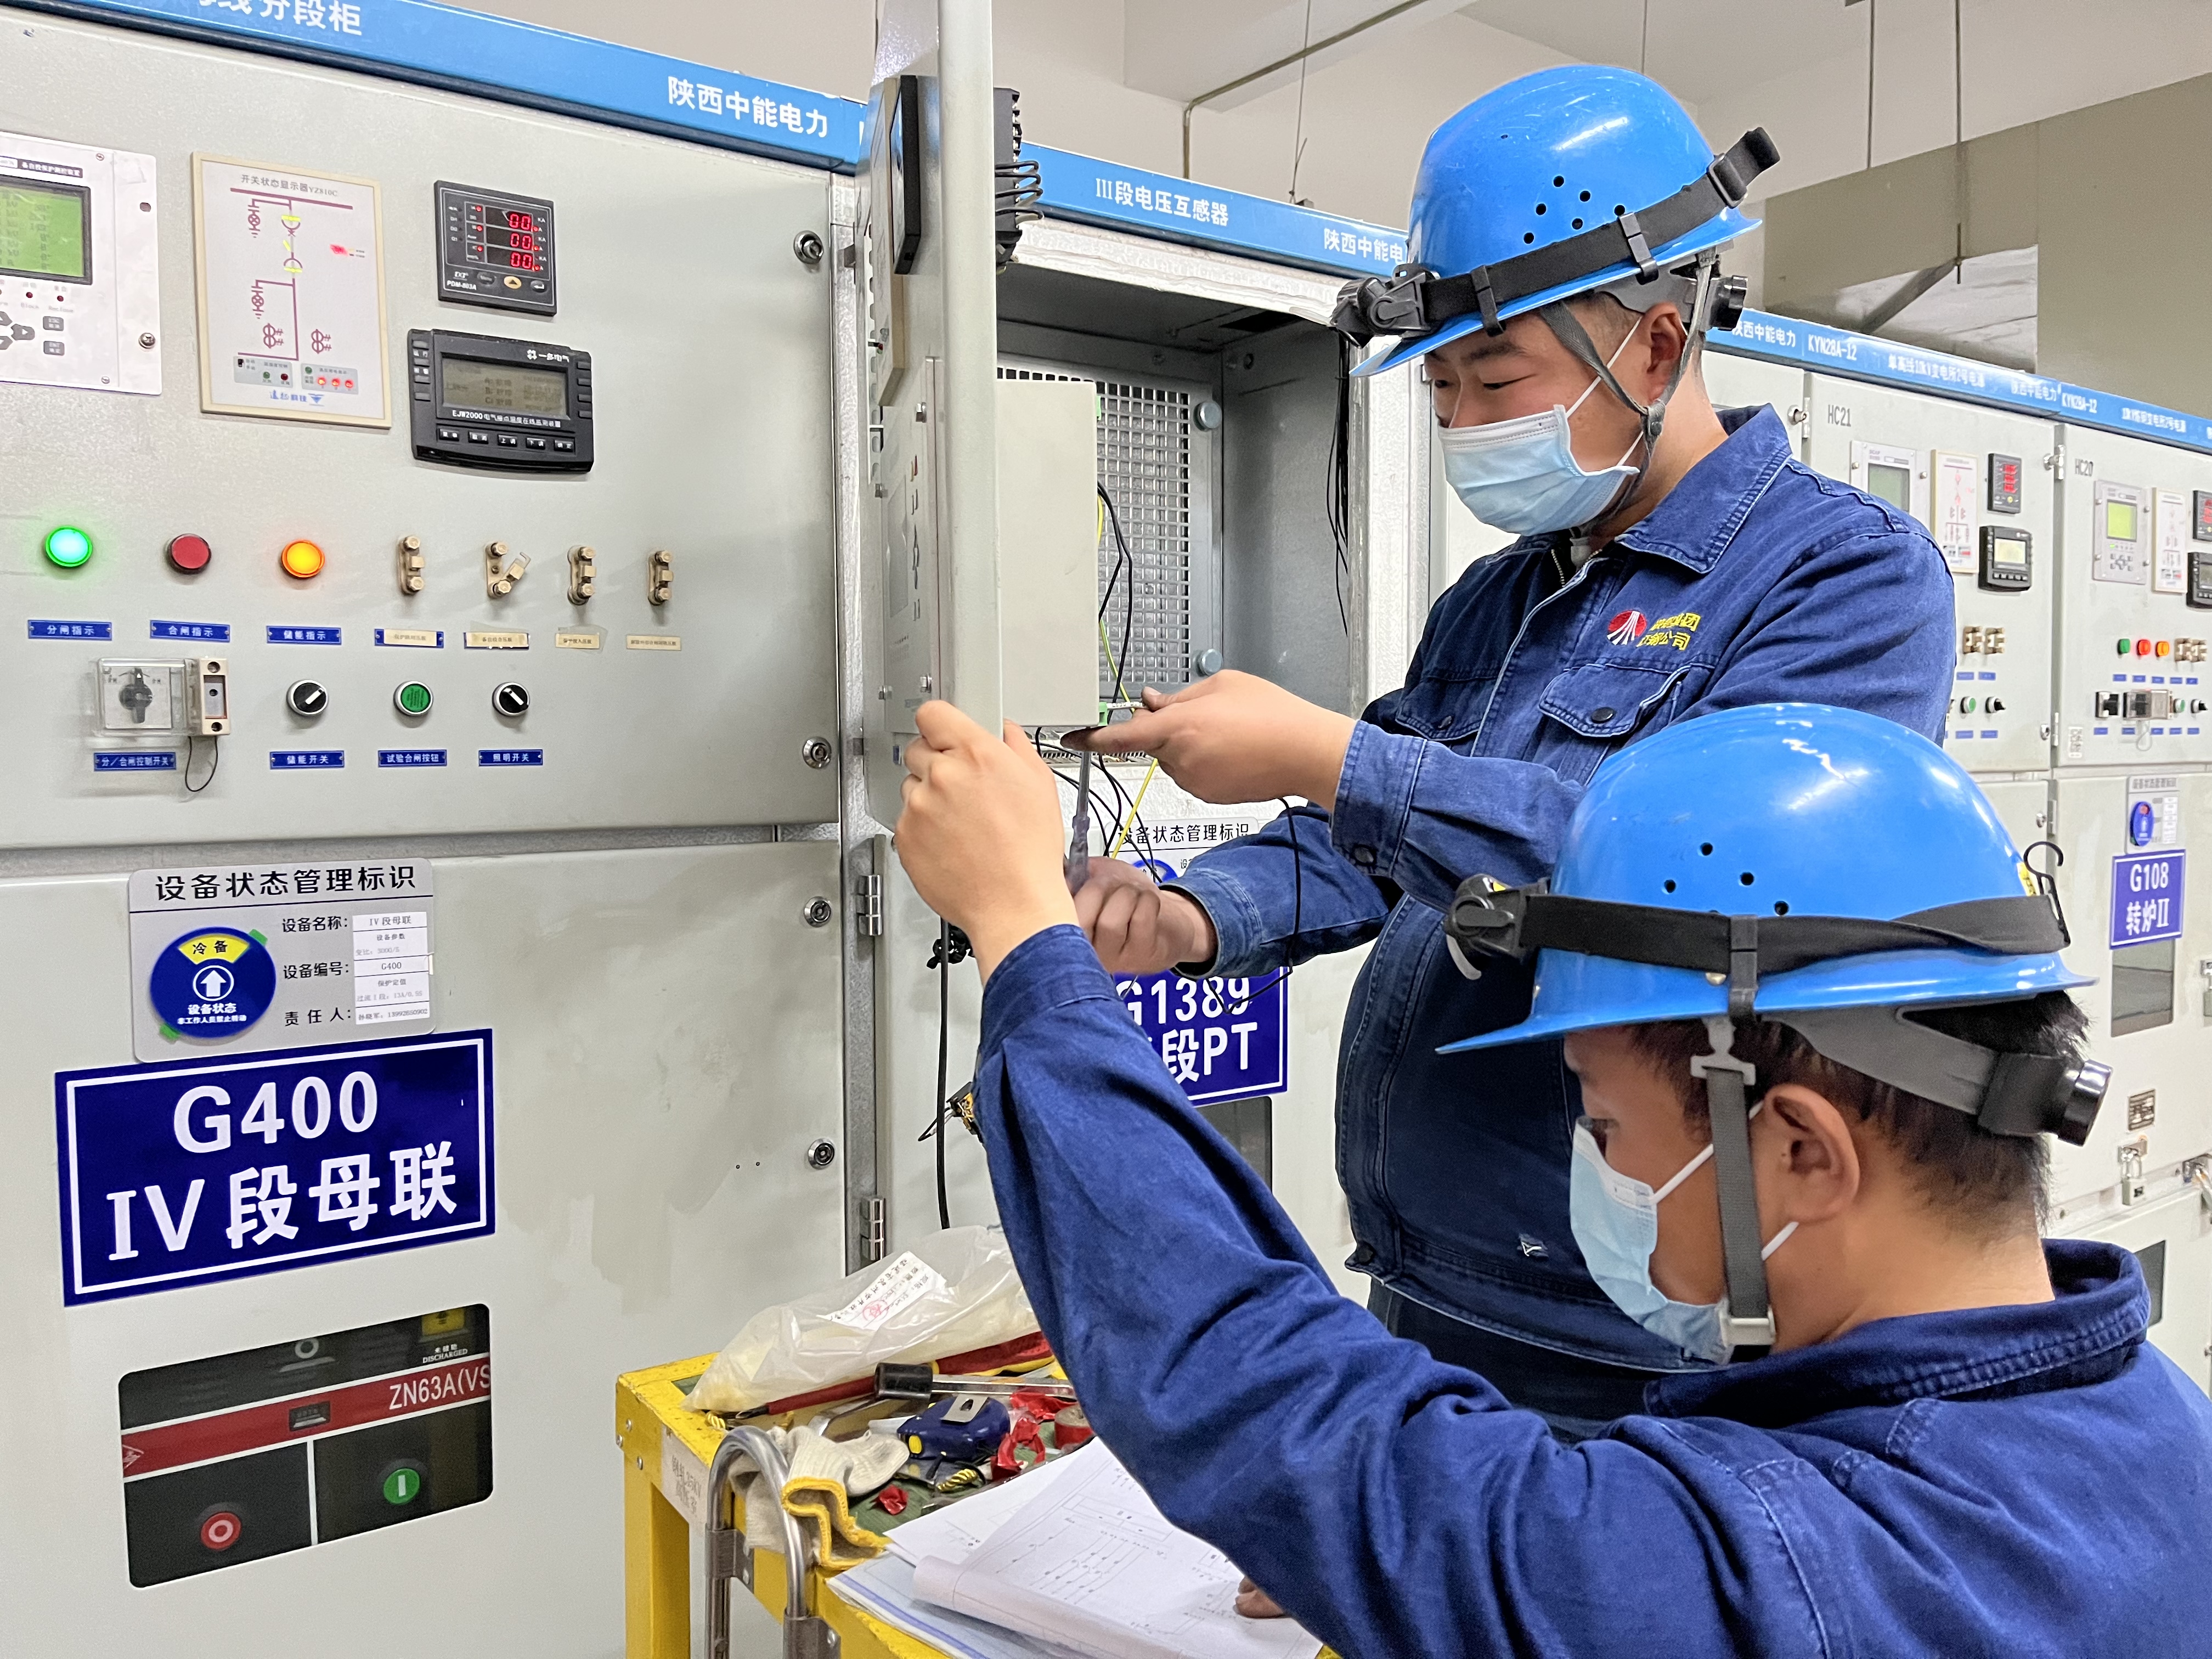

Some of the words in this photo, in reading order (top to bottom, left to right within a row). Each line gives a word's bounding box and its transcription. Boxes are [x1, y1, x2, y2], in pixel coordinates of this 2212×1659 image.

[199, 0, 362, 35] 分段柜
[668, 76, 827, 138] 陕西中能电力
[1324, 228, 1406, 265] 陕西中能电
[1808, 334, 1857, 361] KYN28A-12
[1827, 404, 1852, 427] HC21
[47, 625, 95, 636] 分闸指示
[168, 625, 214, 637] 合闸指示
[283, 630, 326, 641] 储能指示
[287, 754, 330, 764] 储能开关
[386, 753, 439, 763] 试验合闸按钮
[493, 753, 530, 763] 照明开关
[155, 865, 416, 901] 设备状态管理标识
[2130, 862, 2169, 892] G108
[193, 940, 228, 955] 冷备
[381, 962, 402, 970] G400
[188, 1002, 237, 1015] 设备状态
[1148, 1022, 1257, 1085] 段PT
[173, 1071, 377, 1153] G400
[422, 1348, 468, 1364] DISCHARGED
[389, 1364, 490, 1410] ZN63A(VS
